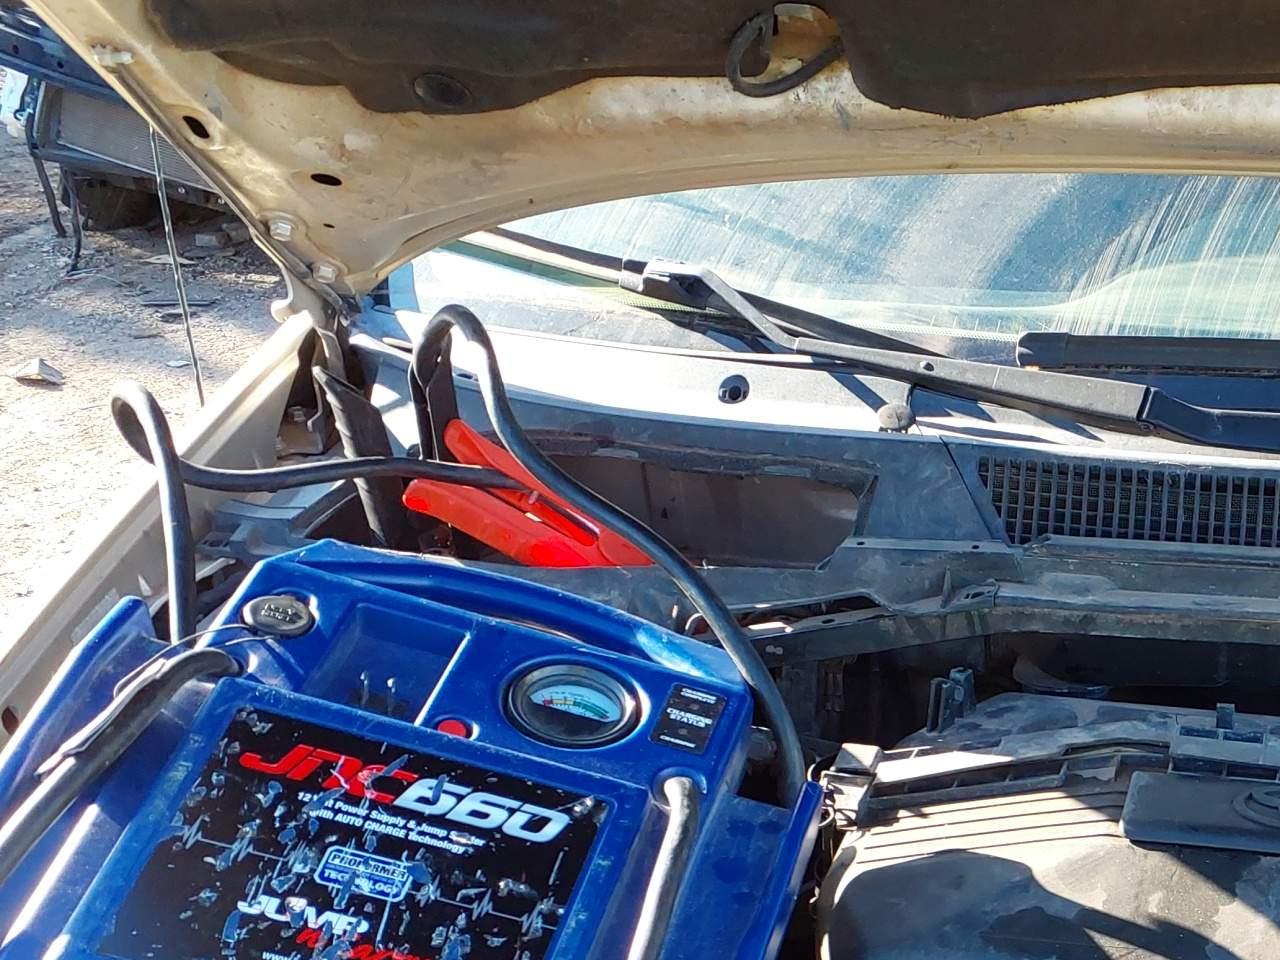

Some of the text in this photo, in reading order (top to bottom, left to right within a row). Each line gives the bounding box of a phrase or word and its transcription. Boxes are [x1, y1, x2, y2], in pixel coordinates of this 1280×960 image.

[666, 707, 713, 725] CHARGING
[669, 713, 706, 728] STATUS
[309, 809, 469, 854] with AUTO CHARGE Technology
[335, 800, 369, 816] Power
[370, 810, 406, 828] Supply
[417, 822, 447, 838] Jump
